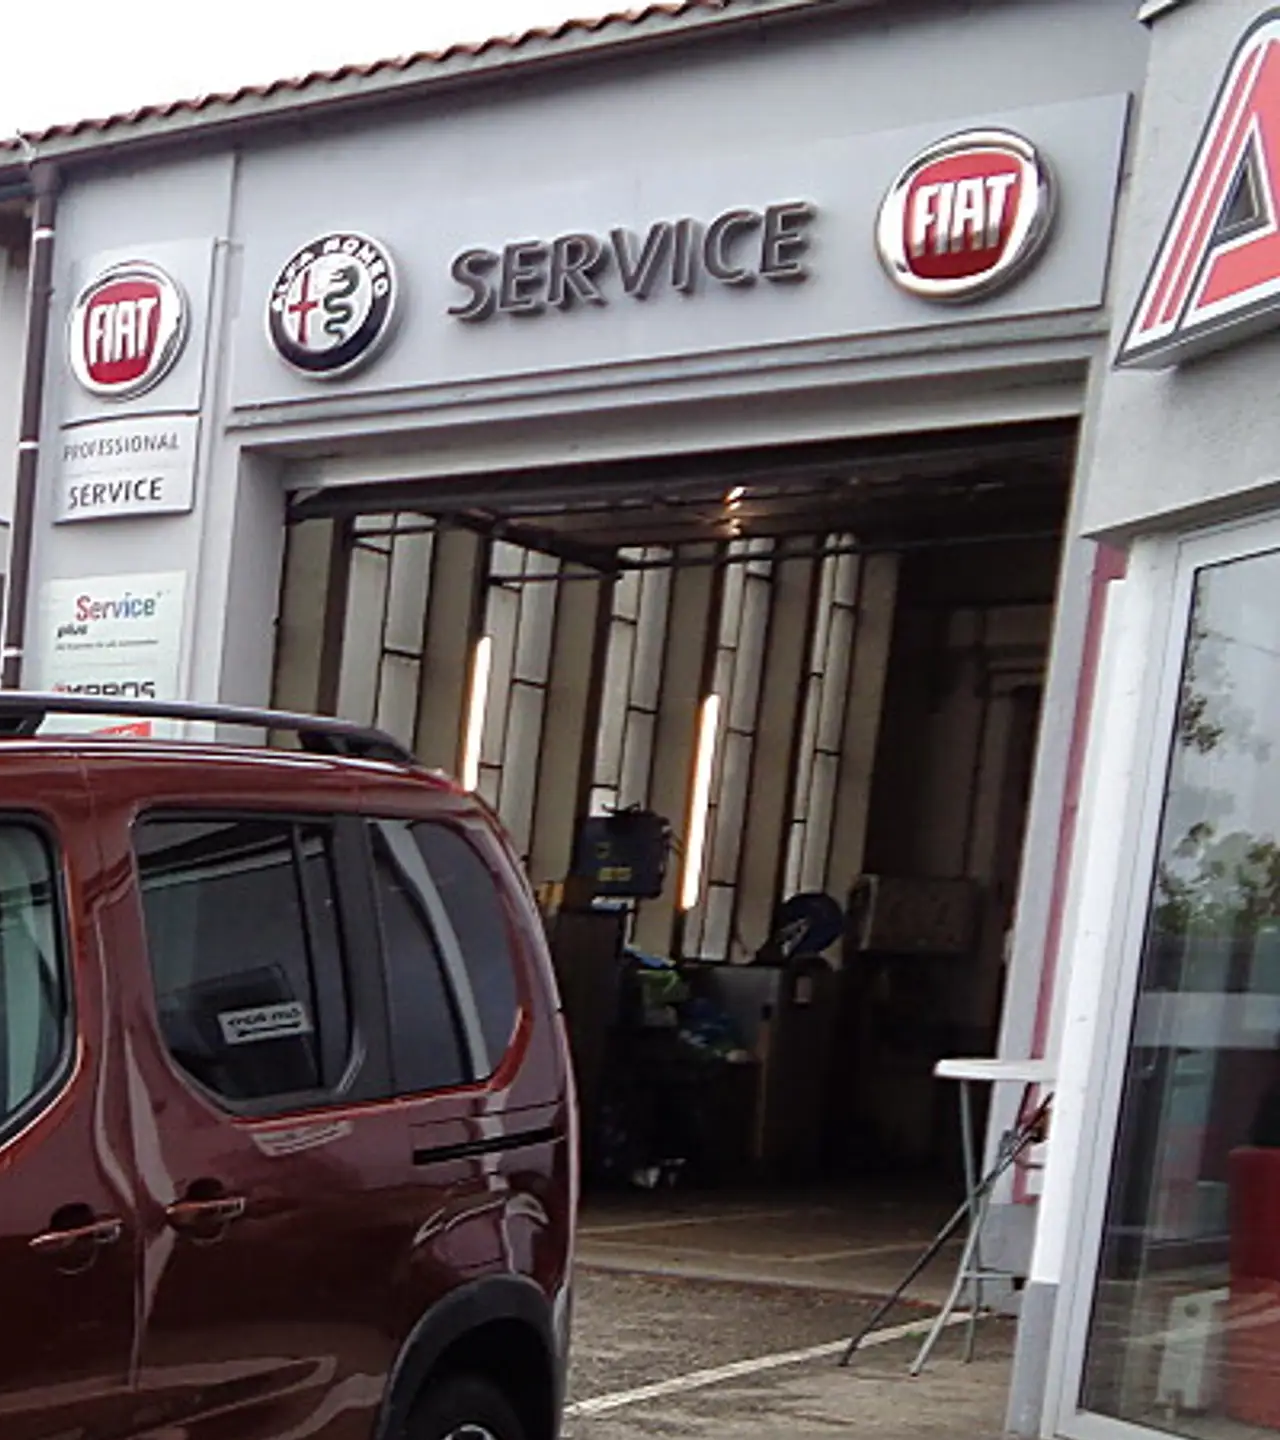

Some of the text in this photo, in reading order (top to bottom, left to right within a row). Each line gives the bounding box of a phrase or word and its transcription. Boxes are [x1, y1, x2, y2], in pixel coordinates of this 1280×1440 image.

[911, 171, 1017, 258] FIAT
[447, 199, 818, 321] SERVICE
[89, 297, 158, 367] FIAT
[63, 432, 180, 462] PROFESSIONAL
[68, 477, 165, 510] SERVICE
[75, 591, 156, 622] Service
